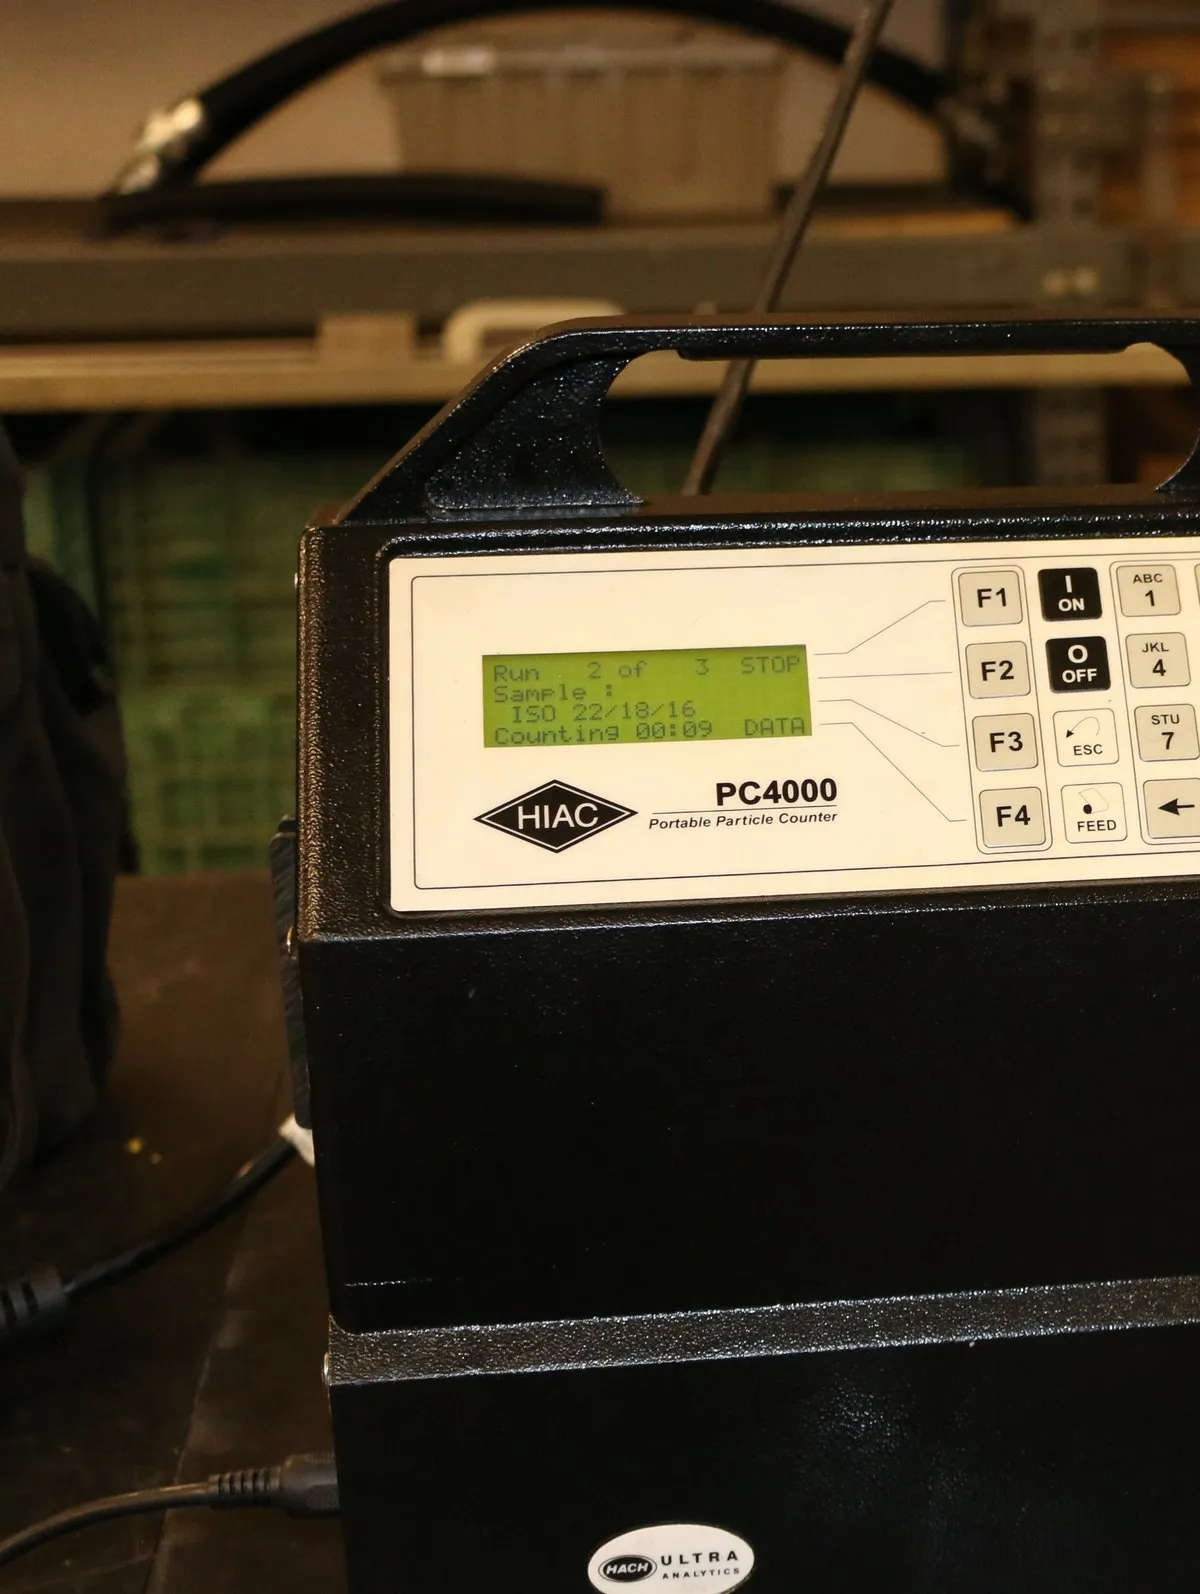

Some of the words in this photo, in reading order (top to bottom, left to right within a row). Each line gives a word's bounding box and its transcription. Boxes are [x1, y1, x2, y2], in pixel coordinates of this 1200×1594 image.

[1132, 573, 1163, 584] ABC
[976, 587, 1007, 609] F1
[1058, 597, 1085, 612] ON
[1145, 589, 1155, 607] 1
[1142, 642, 1169, 653] JKL
[493, 664, 540, 682] Run
[586, 661, 602, 679] 2
[617, 660, 648, 679] of
[695, 658, 710, 676] 3
[740, 655, 801, 675] STOP
[981, 660, 1015, 682] F2
[1061, 668, 1097, 684] OFF
[1152, 658, 1167, 677] 4
[493, 683, 587, 704] Sample
[511, 704, 557, 724] ISO
[572, 699, 697, 723] 22/18/16
[1151, 713, 1180, 726] STU
[493, 724, 620, 745] Counting
[635, 719, 713, 741] 00:09
[743, 716, 806, 737] DATA
[989, 731, 1023, 753] F3
[1073, 743, 1103, 756] ESC
[1161, 731, 1175, 750] 7
[715, 777, 838, 807] PC4000
[516, 802, 600, 831] HIAC
[648, 815, 712, 830] Portable
[715, 813, 775, 828] Particle
[778, 811, 838, 825] Counter
[996, 804, 1031, 828] F4
[1077, 819, 1117, 832] FEED
[660, 1550, 738, 1566] ULTRA
[606, 1561, 649, 1576] HACH
[662, 1568, 740, 1580] ANALYTICS
